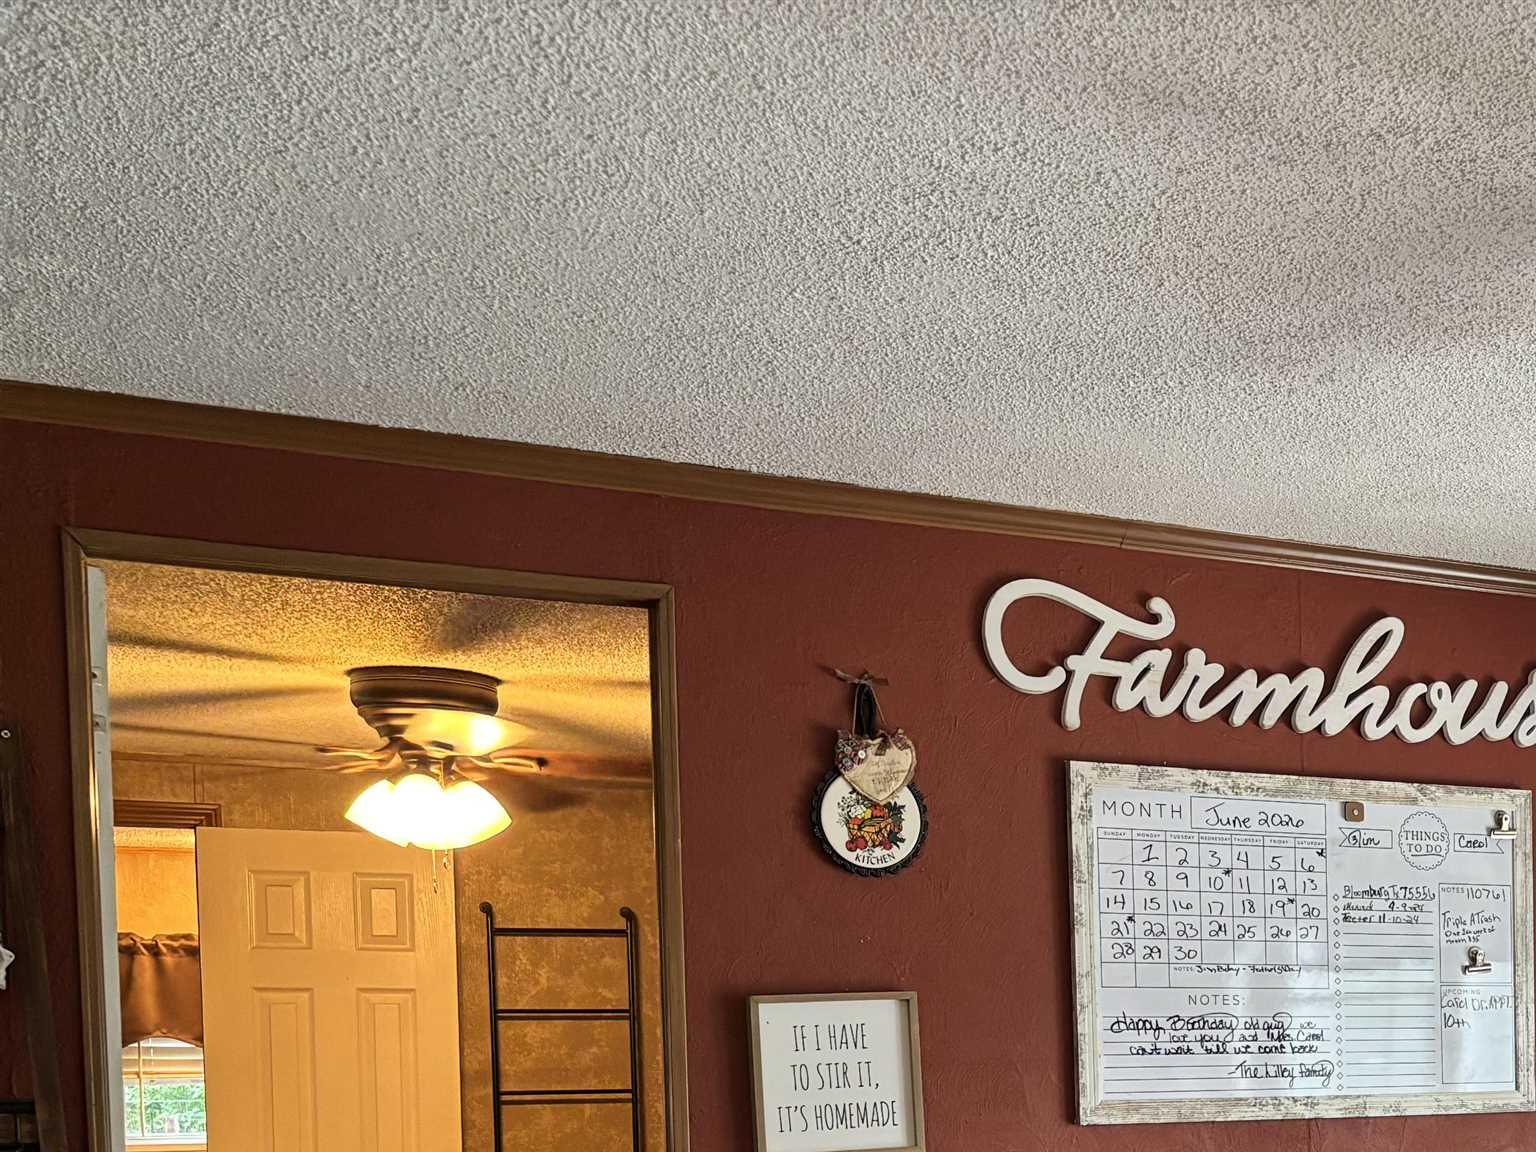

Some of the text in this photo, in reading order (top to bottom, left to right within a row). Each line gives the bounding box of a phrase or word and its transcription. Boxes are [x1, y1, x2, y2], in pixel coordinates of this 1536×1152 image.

[1102, 800, 1182, 819] MONTH
[1205, 802, 1251, 828] June
[1404, 830, 1447, 842] THINGS
[1141, 844, 1315, 872] 1 2 3 4 5 6
[1407, 843, 1443, 853] TO DO
[855, 852, 896, 866] KITCHEN
[1111, 869, 1318, 894] 7 8 9 10 11 12 13
[1106, 894, 1320, 919] 14 15 16 17 18 19 20
[1111, 920, 1319, 940] 21 22 23 24 25 26 27
[1111, 942, 1198, 961] 28 29 30
[1188, 994, 1246, 1006] NOTES:
[1110, 1011, 1165, 1040] Happy
[1167, 1013, 1239, 1040] Birthday
[1244, 1016, 1260, 1030] old
[792, 1023, 869, 1051] IF I HAVE
[1195, 1033, 1220, 1049] you
[1258, 1043, 1287, 1054] come
[789, 1061, 879, 1091] TO STIR IT,
[777, 1100, 899, 1133] IT'S HOMEMADE
